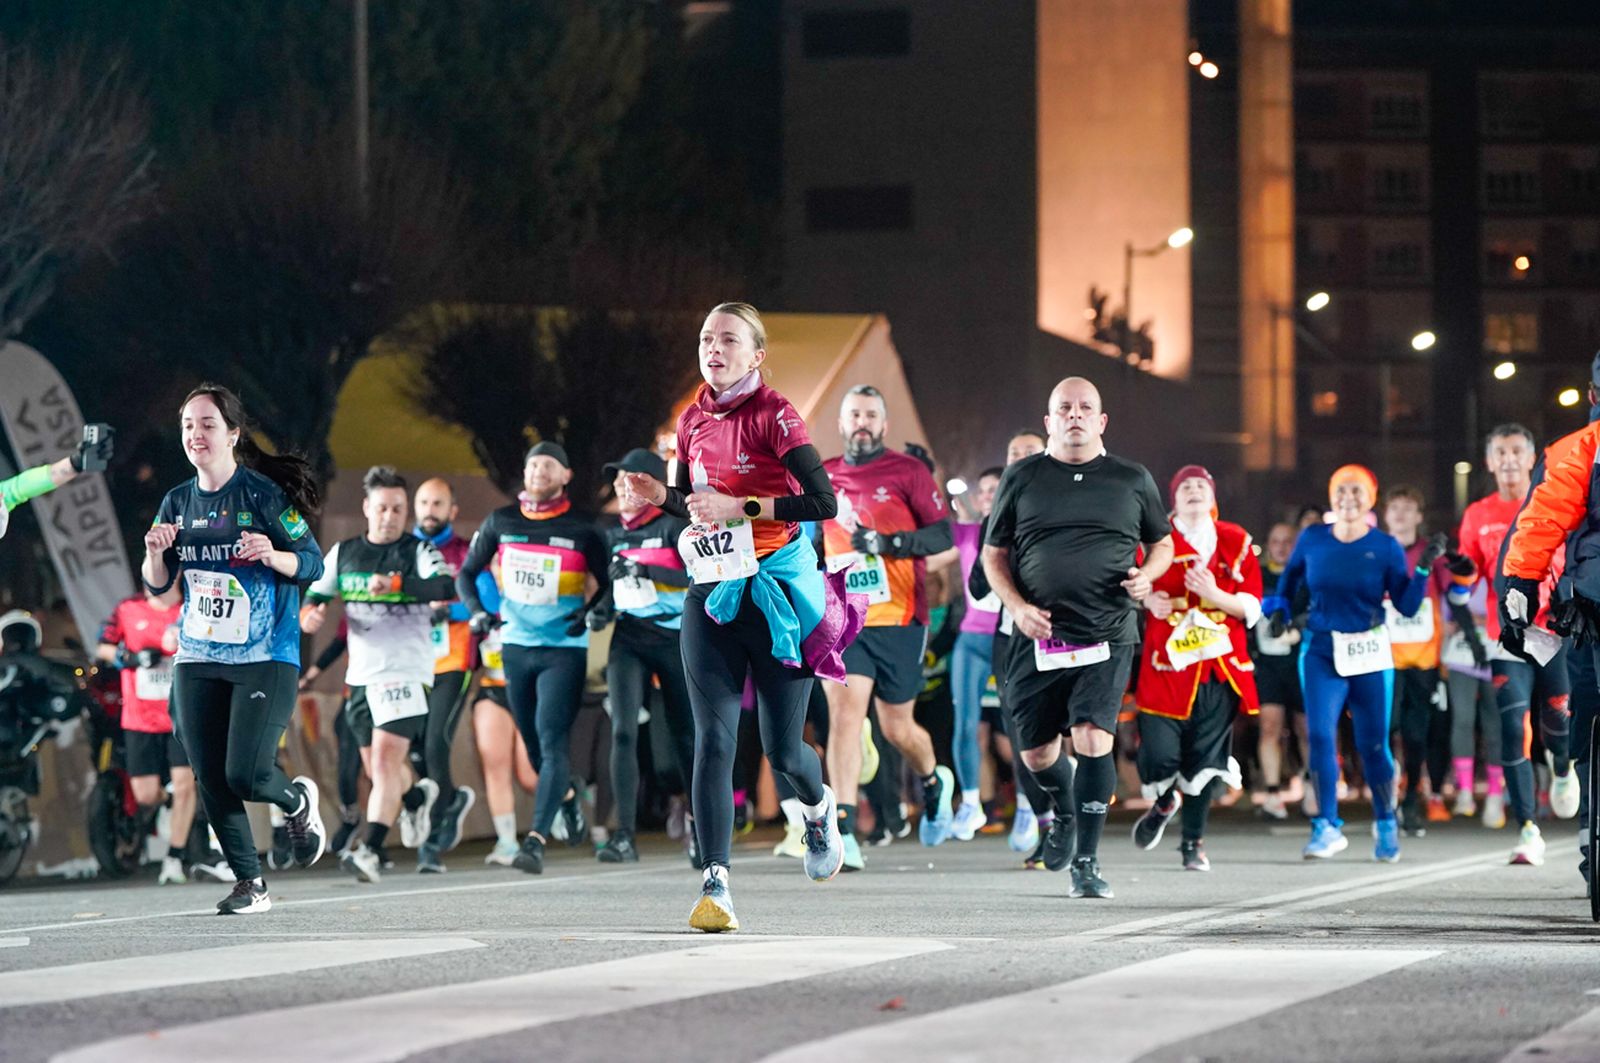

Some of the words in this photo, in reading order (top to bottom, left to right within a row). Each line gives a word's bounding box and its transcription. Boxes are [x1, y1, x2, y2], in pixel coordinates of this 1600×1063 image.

[40, 384, 122, 570] JAPEASA
[176, 546, 198, 562] SAN
[201, 538, 242, 561] ANTÓ
[691, 531, 734, 558] 1812
[515, 570, 545, 588] 1765
[845, 569, 879, 588] 039
[198, 596, 235, 618] 4037
[1347, 640, 1379, 656] 6515
